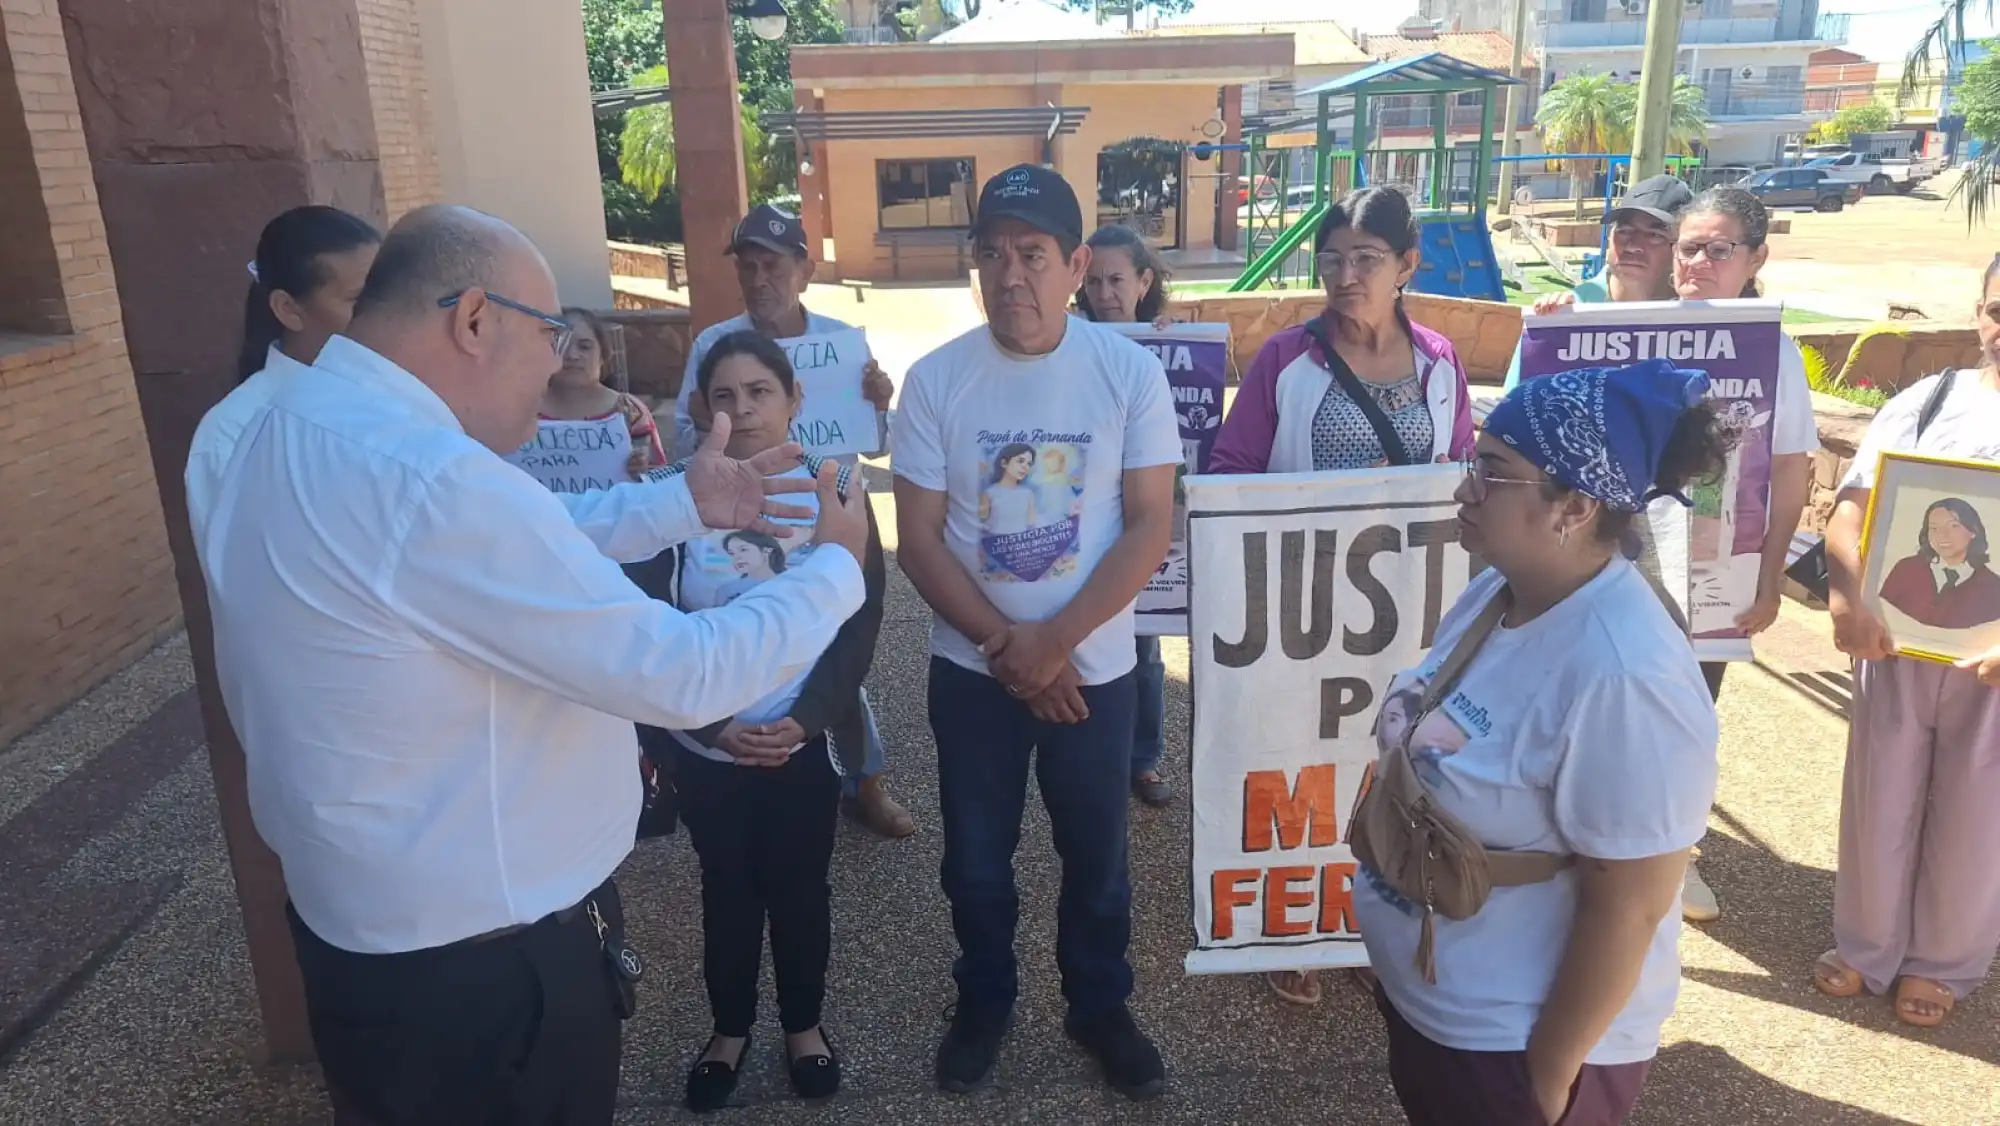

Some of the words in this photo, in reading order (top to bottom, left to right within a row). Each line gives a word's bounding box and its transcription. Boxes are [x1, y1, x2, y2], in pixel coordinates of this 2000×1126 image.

[783, 340, 839, 370] CIA
[1557, 329, 1737, 361] JUSTICIA
[1012, 429, 1028, 443] de
[1031, 428, 1094, 444] Fernanda
[520, 454, 580, 469] PARA
[993, 527, 1049, 546] JUSTICIA
[1212, 518, 1489, 668] JUST
